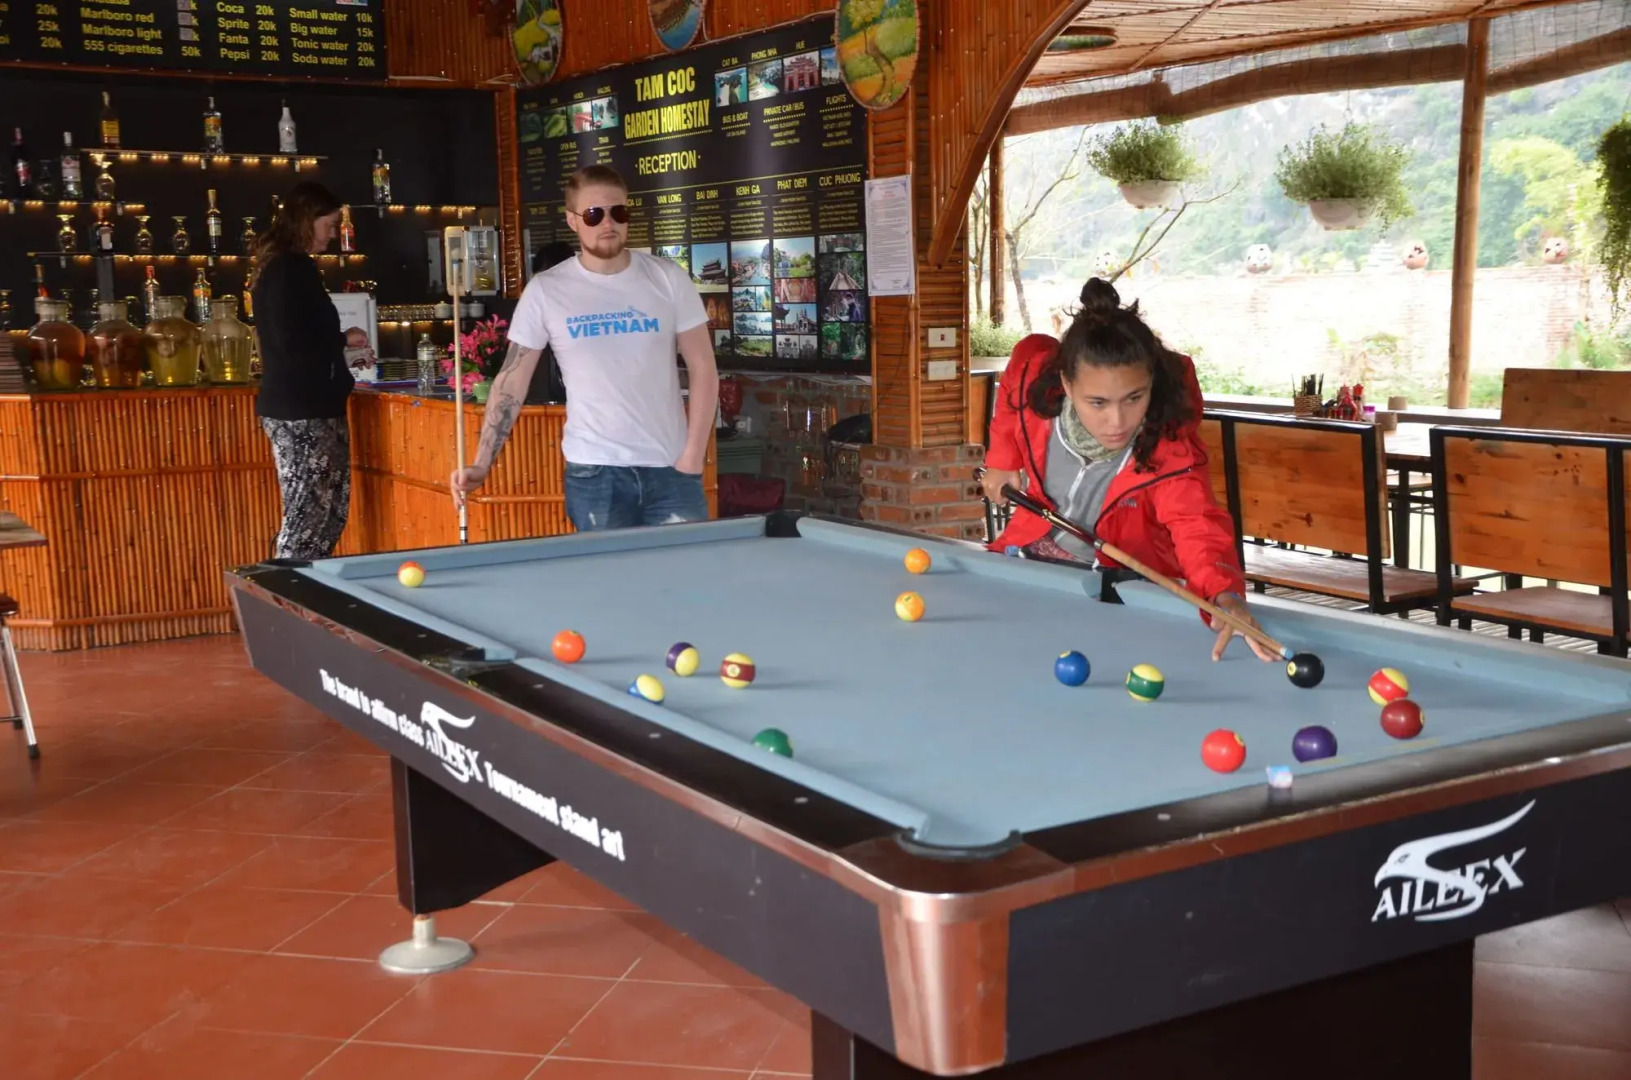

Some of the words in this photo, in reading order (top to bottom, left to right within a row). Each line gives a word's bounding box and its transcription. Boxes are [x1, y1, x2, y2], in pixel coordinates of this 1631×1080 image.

[36, 4, 58, 15] 20k
[80, 7, 133, 21] Marlboro
[135, 13, 155, 23] red
[216, 2, 245, 14] Coca
[255, 5, 275, 16] 20k
[289, 8, 319, 20] Small
[320, 11, 348, 22] water
[355, 13, 373, 23] 10k
[38, 20, 60, 31] 25k
[217, 17, 249, 30] Sprite
[257, 20, 277, 31] 20k
[290, 23, 308, 36] Big
[310, 26, 338, 36] water
[356, 28, 374, 38] 15k
[82, 24, 135, 37] Marlboro
[136, 28, 162, 41] light
[218, 33, 249, 45] Fanta
[260, 36, 279, 46] 20k
[40, 36, 62, 48] 20k
[84, 40, 105, 51] 555
[107, 43, 163, 55] cigarettes
[181, 46, 201, 57] 50k
[290, 38, 319, 50] Tonic
[321, 41, 348, 51] water
[357, 42, 375, 53] 20k
[220, 48, 250, 61] Pepsi
[261, 51, 280, 61] 20k
[292, 53, 319, 65] Soda
[320, 56, 348, 66] water
[357, 57, 376, 67] 20k
[635, 73, 664, 102] TAM
[667, 66, 696, 96] COC
[763, 104, 781, 116] PRIVATE
[624, 108, 660, 139] GARDEN
[660, 98, 710, 134] HOMESTAY
[638, 150, 697, 175] RECEPTION
[777, 179, 792, 190] PHAT
[819, 175, 833, 186] CUC
[835, 172, 861, 185] PHUONG
[668, 193, 682, 204] LONG
[566, 311, 634, 325] BACKPACKING
[567, 318, 660, 339] VIETNAM
[484, 760, 560, 825] Tournament
